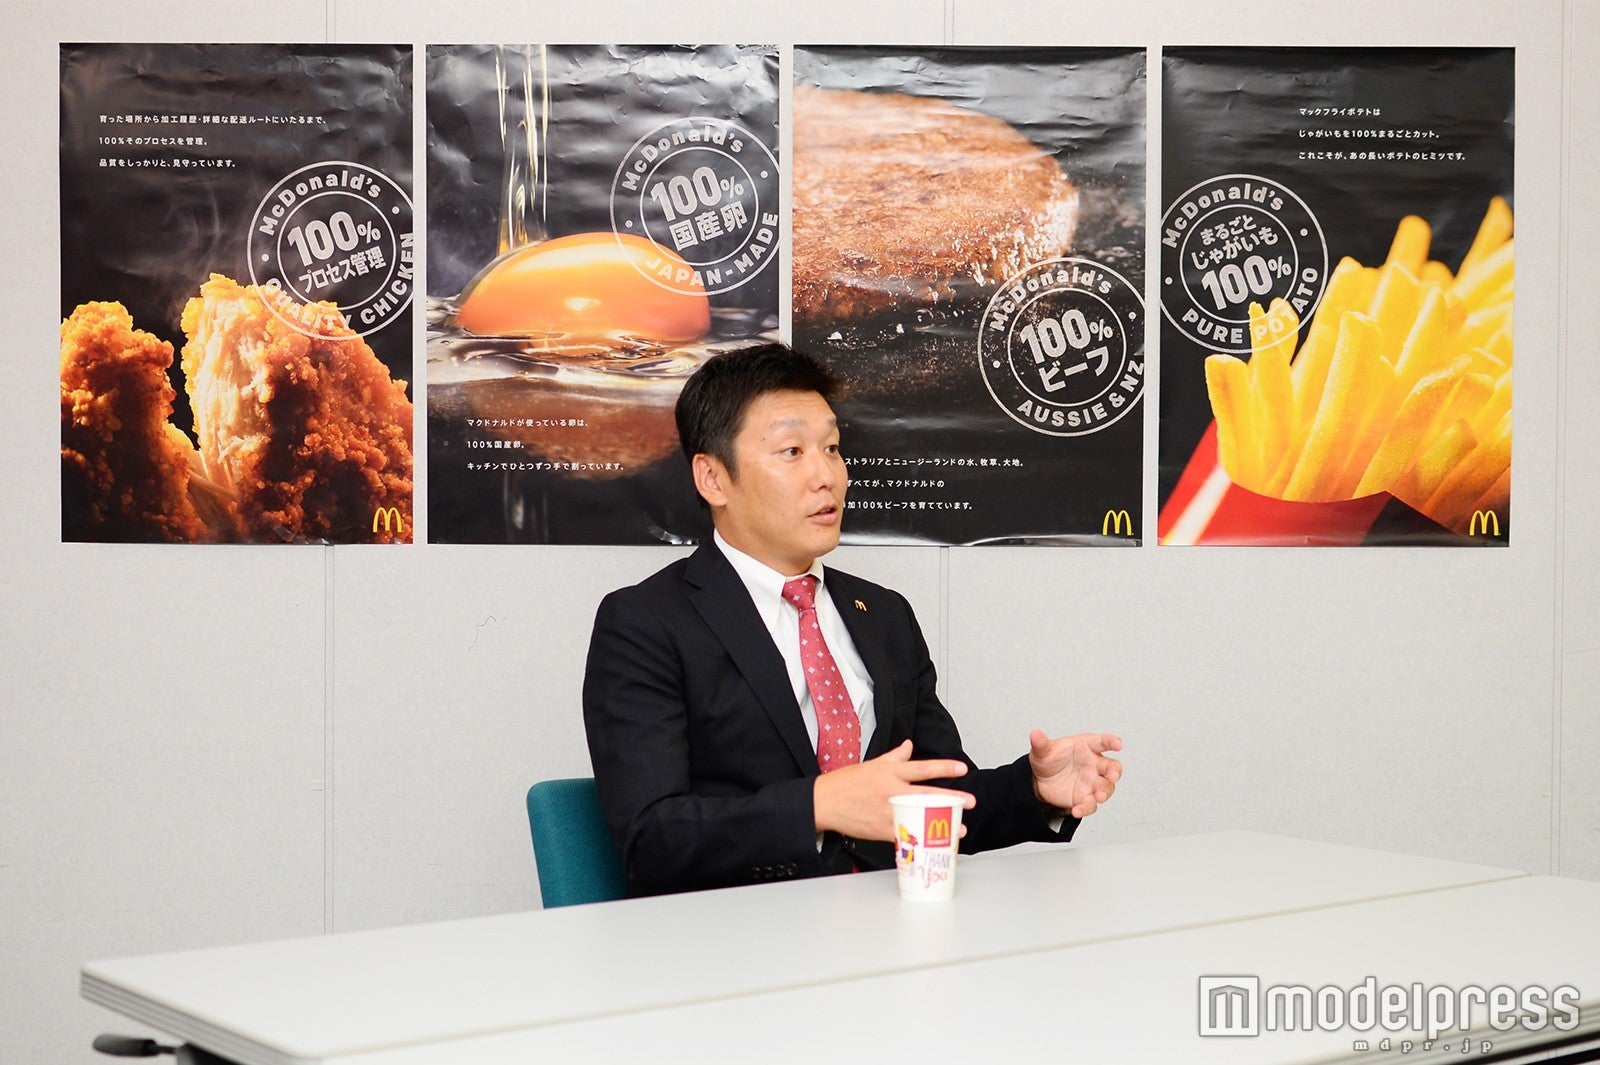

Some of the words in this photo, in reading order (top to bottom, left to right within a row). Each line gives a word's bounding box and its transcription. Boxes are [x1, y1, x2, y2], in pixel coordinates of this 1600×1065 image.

[1299, 108, 1380, 116] マックフライポテトは
[1299, 129, 1440, 138] じゃがいもを100%まるごとカット。
[99, 137, 208, 146] 100%そのプロセスを管理。
[99, 159, 236, 168] 品質をしっかりと、見守っています。
[622, 125, 744, 191] McDonald's
[1299, 152, 1466, 160] これこそが、あの長いポテトのヒミツです。
[258, 170, 382, 236] McDonald's
[650, 166, 744, 222] 100%
[1162, 183, 1284, 248] McDonald's
[287, 211, 382, 267] 100%
[646, 212, 778, 287] JAPAN-MADE
[669, 201, 748, 251] 国産卵
[1191, 226, 1278, 270] じゃがいも
[1200, 214, 1257, 246] まるごと
[265, 277, 352, 331] QUALITY
[360, 232, 413, 325] CHICKEN
[299, 245, 387, 294] プロセス管理
[1202, 255, 1292, 311] 100%
[990, 266, 1112, 332] McDonald's
[1182, 308, 1243, 344] PURE
[1254, 267, 1318, 341] POTATO
[1019, 309, 1114, 365] 100%
[1017, 399, 1108, 427] AUSSIE
[1119, 360, 1144, 393] NZ
[1039, 345, 1110, 393] ビーフ
[467, 419, 589, 427] マクドナルドが使っている卵は、
[467, 441, 525, 449] 100%国産卵。
[467, 462, 624, 471] キッチンでひとつずつ手で割っています。
[843, 501, 972, 510] 加100%ビーフを育てています。
